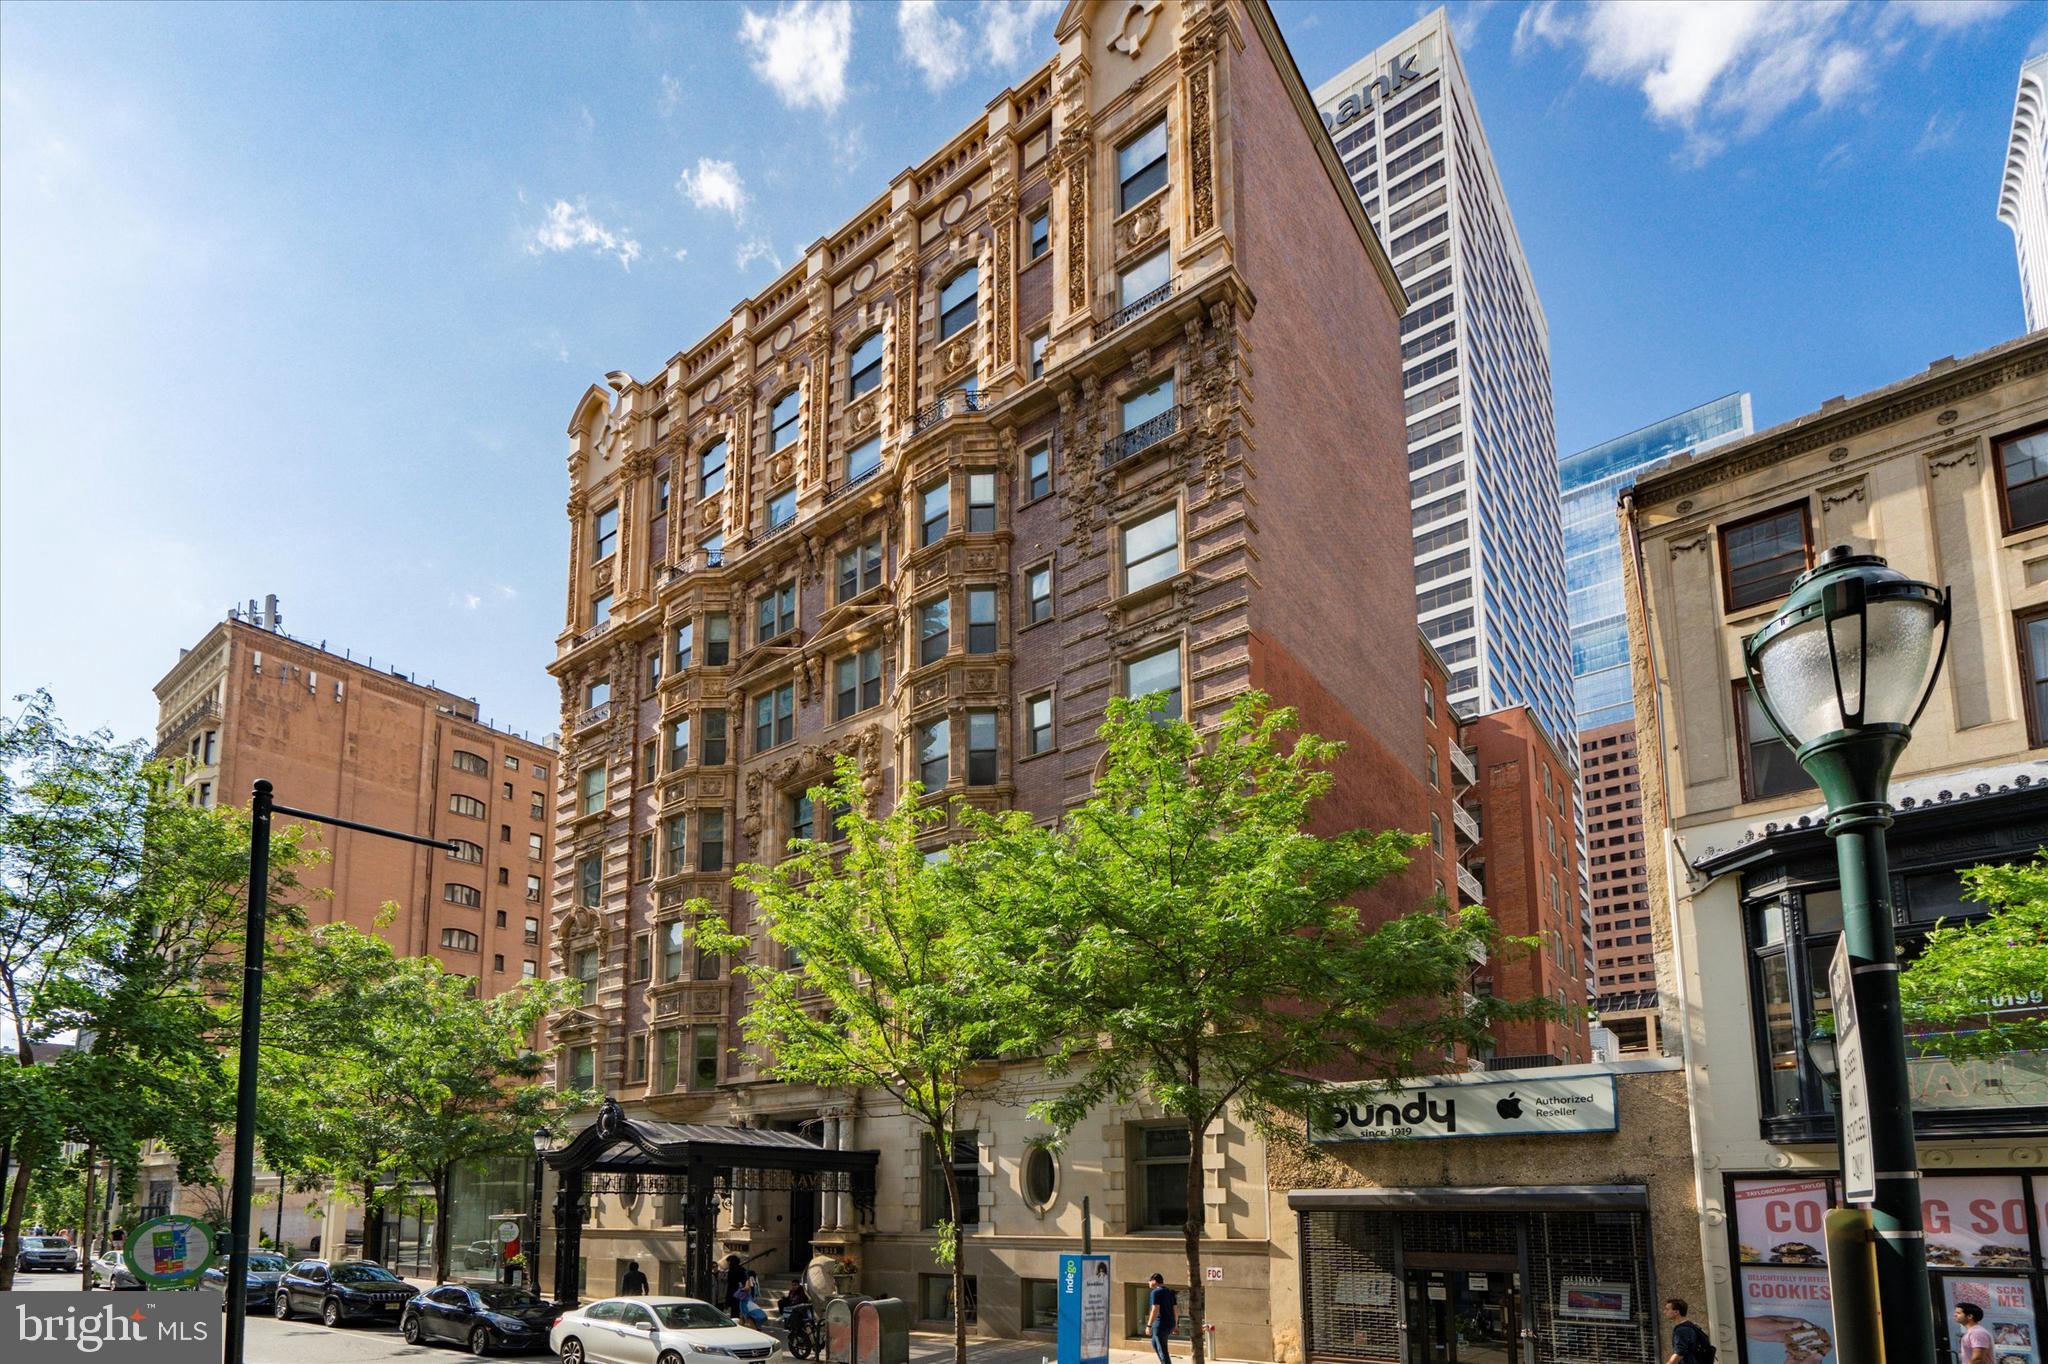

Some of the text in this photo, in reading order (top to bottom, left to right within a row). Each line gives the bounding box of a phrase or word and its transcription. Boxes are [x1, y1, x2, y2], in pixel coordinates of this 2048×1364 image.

[1536, 1094, 1594, 1105] Authorized
[1536, 1107, 1577, 1117] Reseller
[1360, 1127, 1412, 1137] since 1919
[1207, 1269, 1222, 1279] FDC
[1748, 1282, 1831, 1300] COOKIES
[1996, 1286, 2024, 1295] SCAN
[1998, 1295, 2026, 1308] ME!
